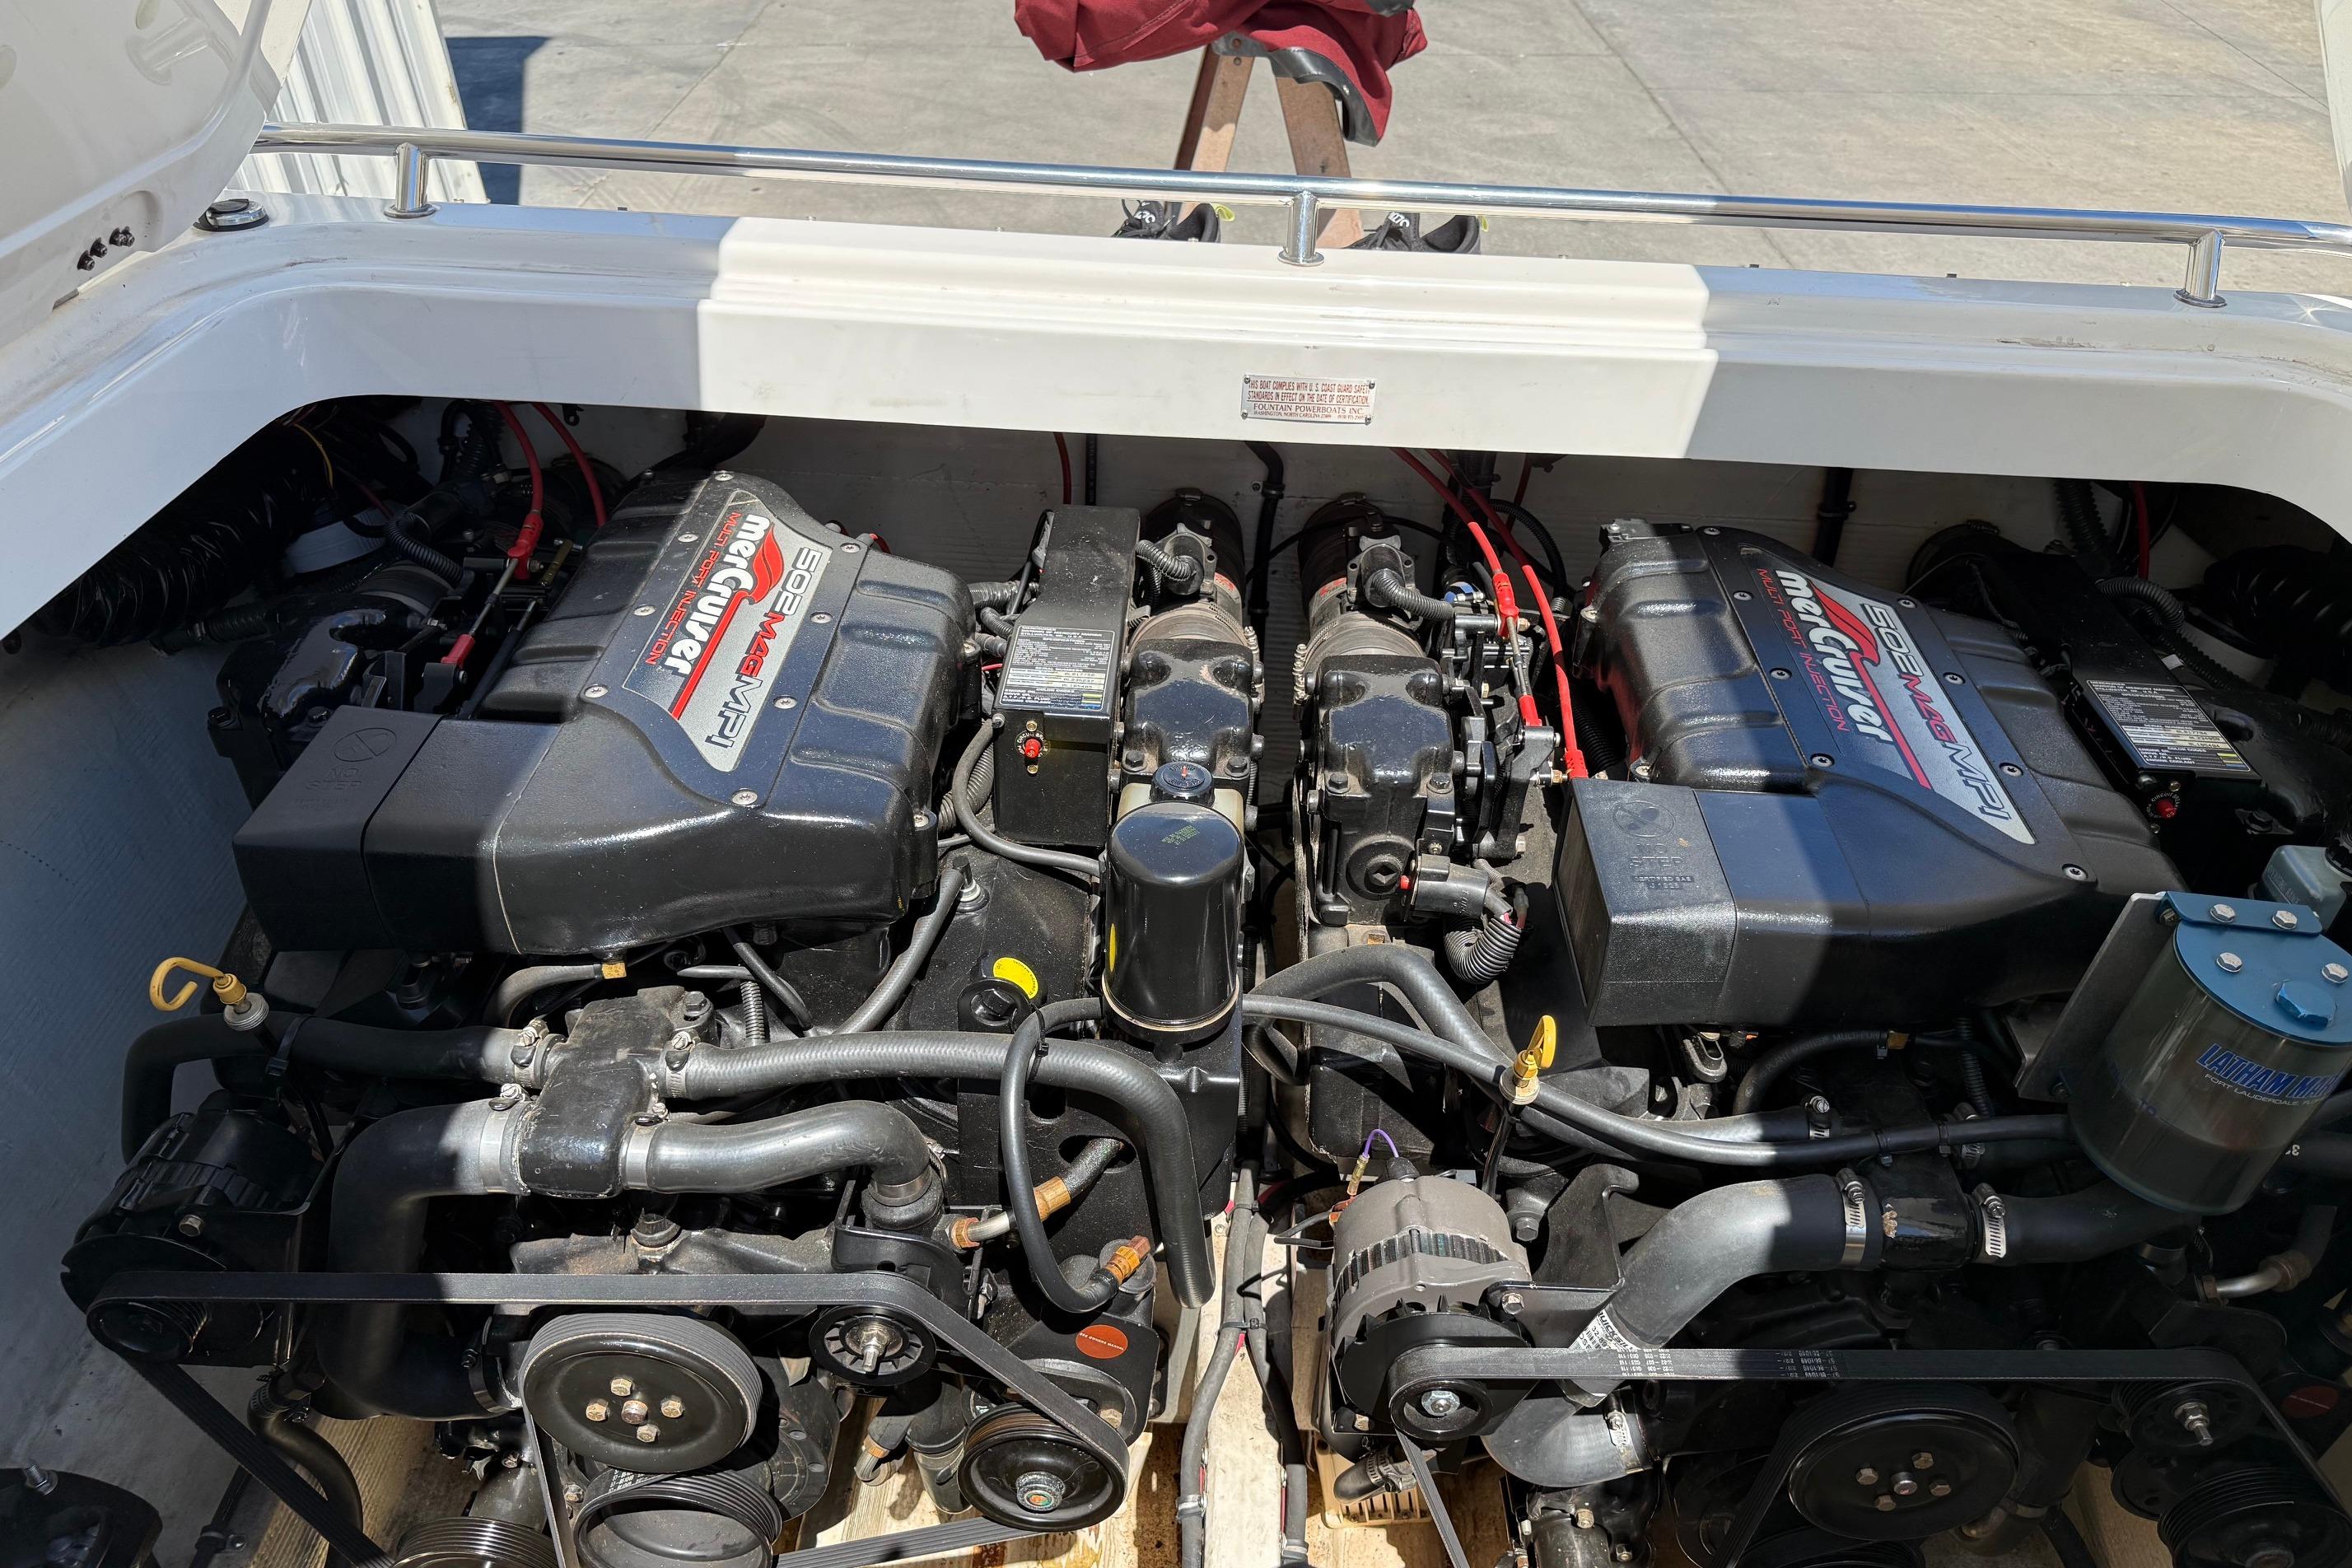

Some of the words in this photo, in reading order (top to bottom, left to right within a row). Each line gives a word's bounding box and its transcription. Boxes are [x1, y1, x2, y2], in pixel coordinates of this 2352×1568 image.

[1248, 391, 1273, 400] STANDARDS
[1281, 393, 1297, 401] EFFECT
[1316, 394, 1327, 403] DATE
[1249, 380, 1258, 389] THIS
[1260, 381, 1271, 390] BOAT
[1272, 381, 1295, 390] COMPLIES
[1296, 383, 1307, 391] WITH
[1321, 384, 1336, 392] COAST
[1295, 405, 1346, 414] POWERBOATS
[716, 511, 741, 546] MULTI
[691, 549, 721, 588] PORT
[774, 547, 823, 616] 502
[646, 590, 697, 665] INJECTION
[740, 612, 786, 678] MAG
[1757, 567, 1783, 605] MULTI
[1778, 608, 1807, 646] PORT
[1799, 651, 1850, 732] INJECTION
[706, 676, 763, 748] MPI
[1859, 603, 1924, 678] 502
[1897, 674, 1958, 744] MAG
[1942, 743, 2012, 821] MPI
[305, 780, 362, 790] STEP
[1629, 856, 1684, 868] STEP
[1634, 843, 1668, 853] NO
[2196, 1043, 2298, 1098] LATHAM
[2204, 1074, 2233, 1090] FORT
[1108, 1342, 1124, 1351] MANUAL
